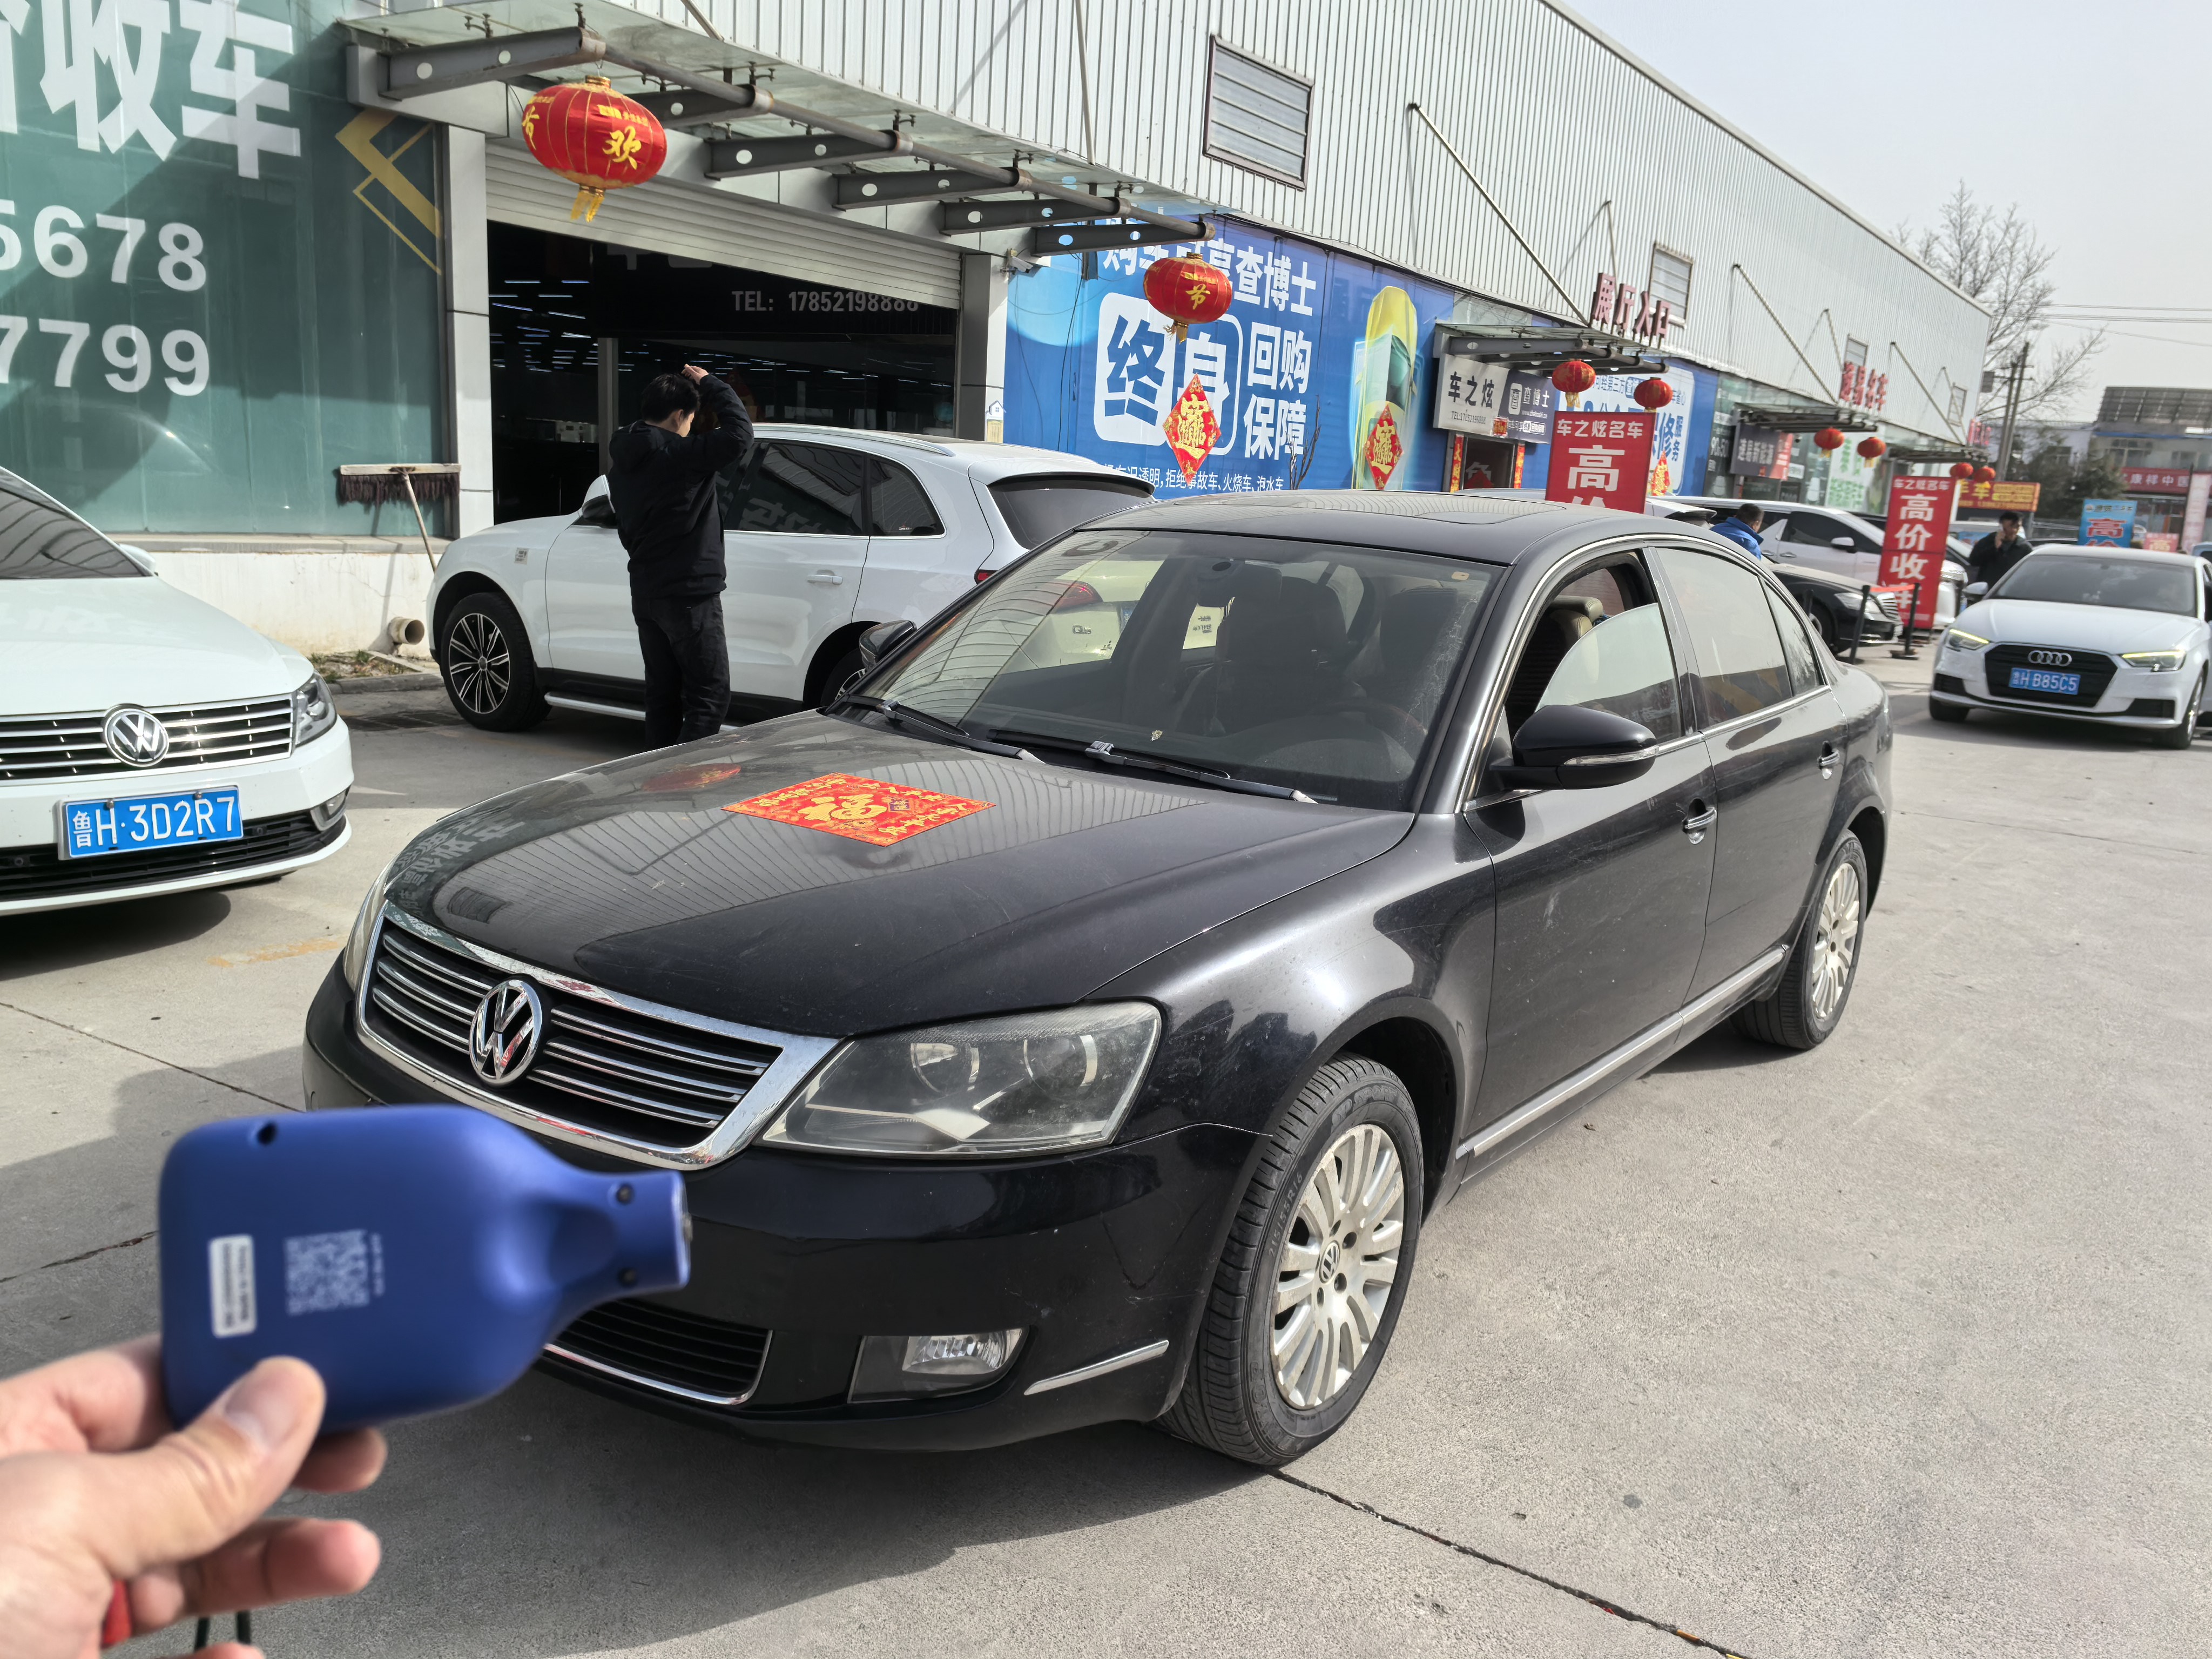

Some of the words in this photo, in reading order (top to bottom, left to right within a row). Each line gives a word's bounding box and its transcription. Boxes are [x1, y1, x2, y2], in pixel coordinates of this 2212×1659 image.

[602, 126, 642, 170] 欢
[731, 291, 773, 311] TEL:
[1185, 284, 1210, 309] 节
[1591, 273, 1671, 339] 展厅入口
[1247, 322, 1312, 394] 回购
[1448, 371, 1495, 409] 车之炫
[1523, 386, 1550, 408] 查博士
[1243, 394, 1307, 460] 保障
[1557, 419, 1644, 439] 车之炫名车
[1568, 445, 1626, 506] 高
[1889, 494, 1939, 609] 高价收车
[797, 793, 887, 822] 福
